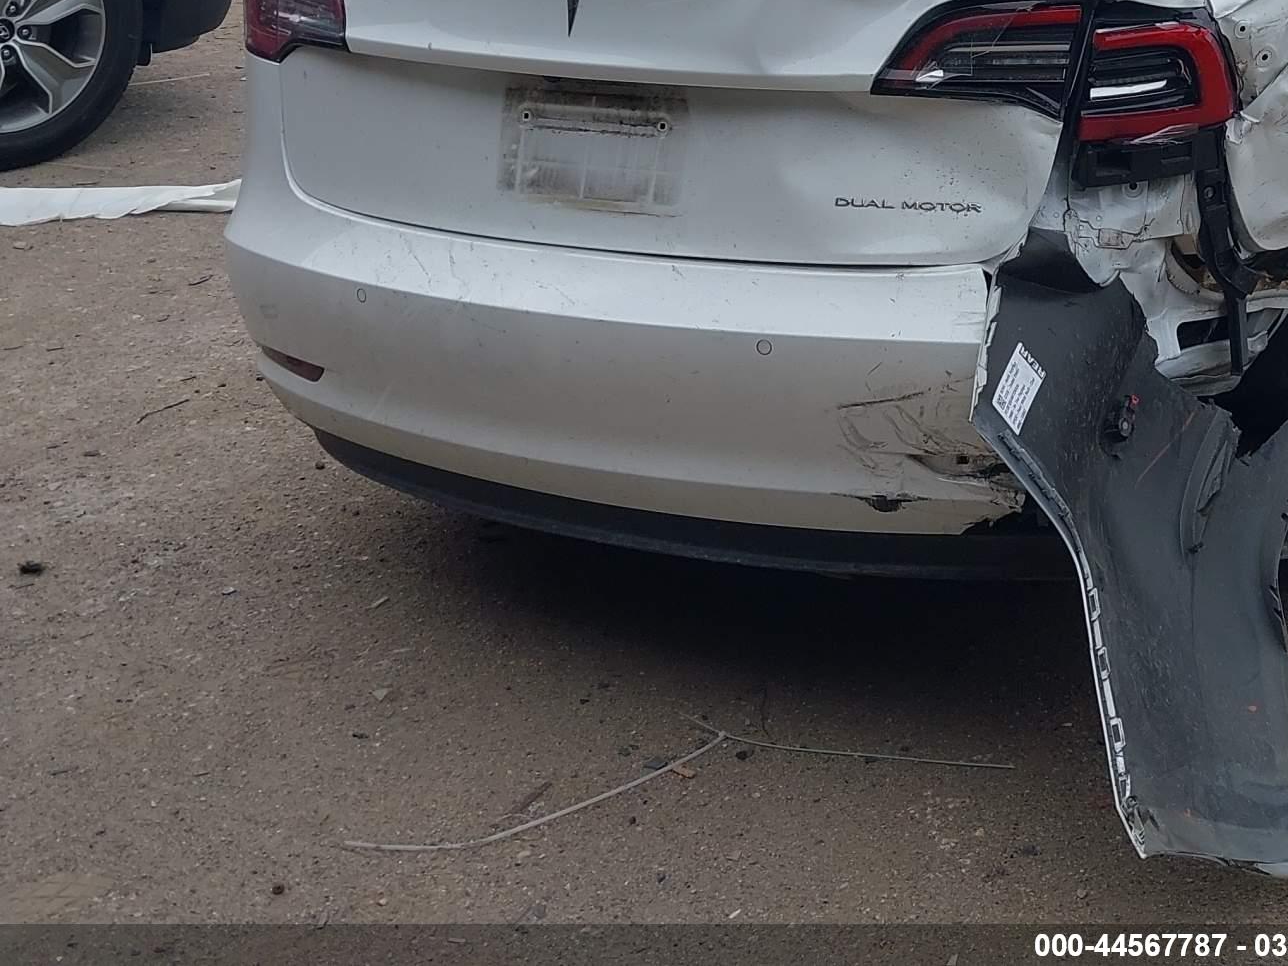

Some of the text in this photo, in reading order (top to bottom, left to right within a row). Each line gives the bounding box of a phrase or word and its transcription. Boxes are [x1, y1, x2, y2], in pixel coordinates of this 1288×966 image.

[834, 197, 982, 213] DUAL MOTOR
[1020, 346, 1046, 378] REAR
